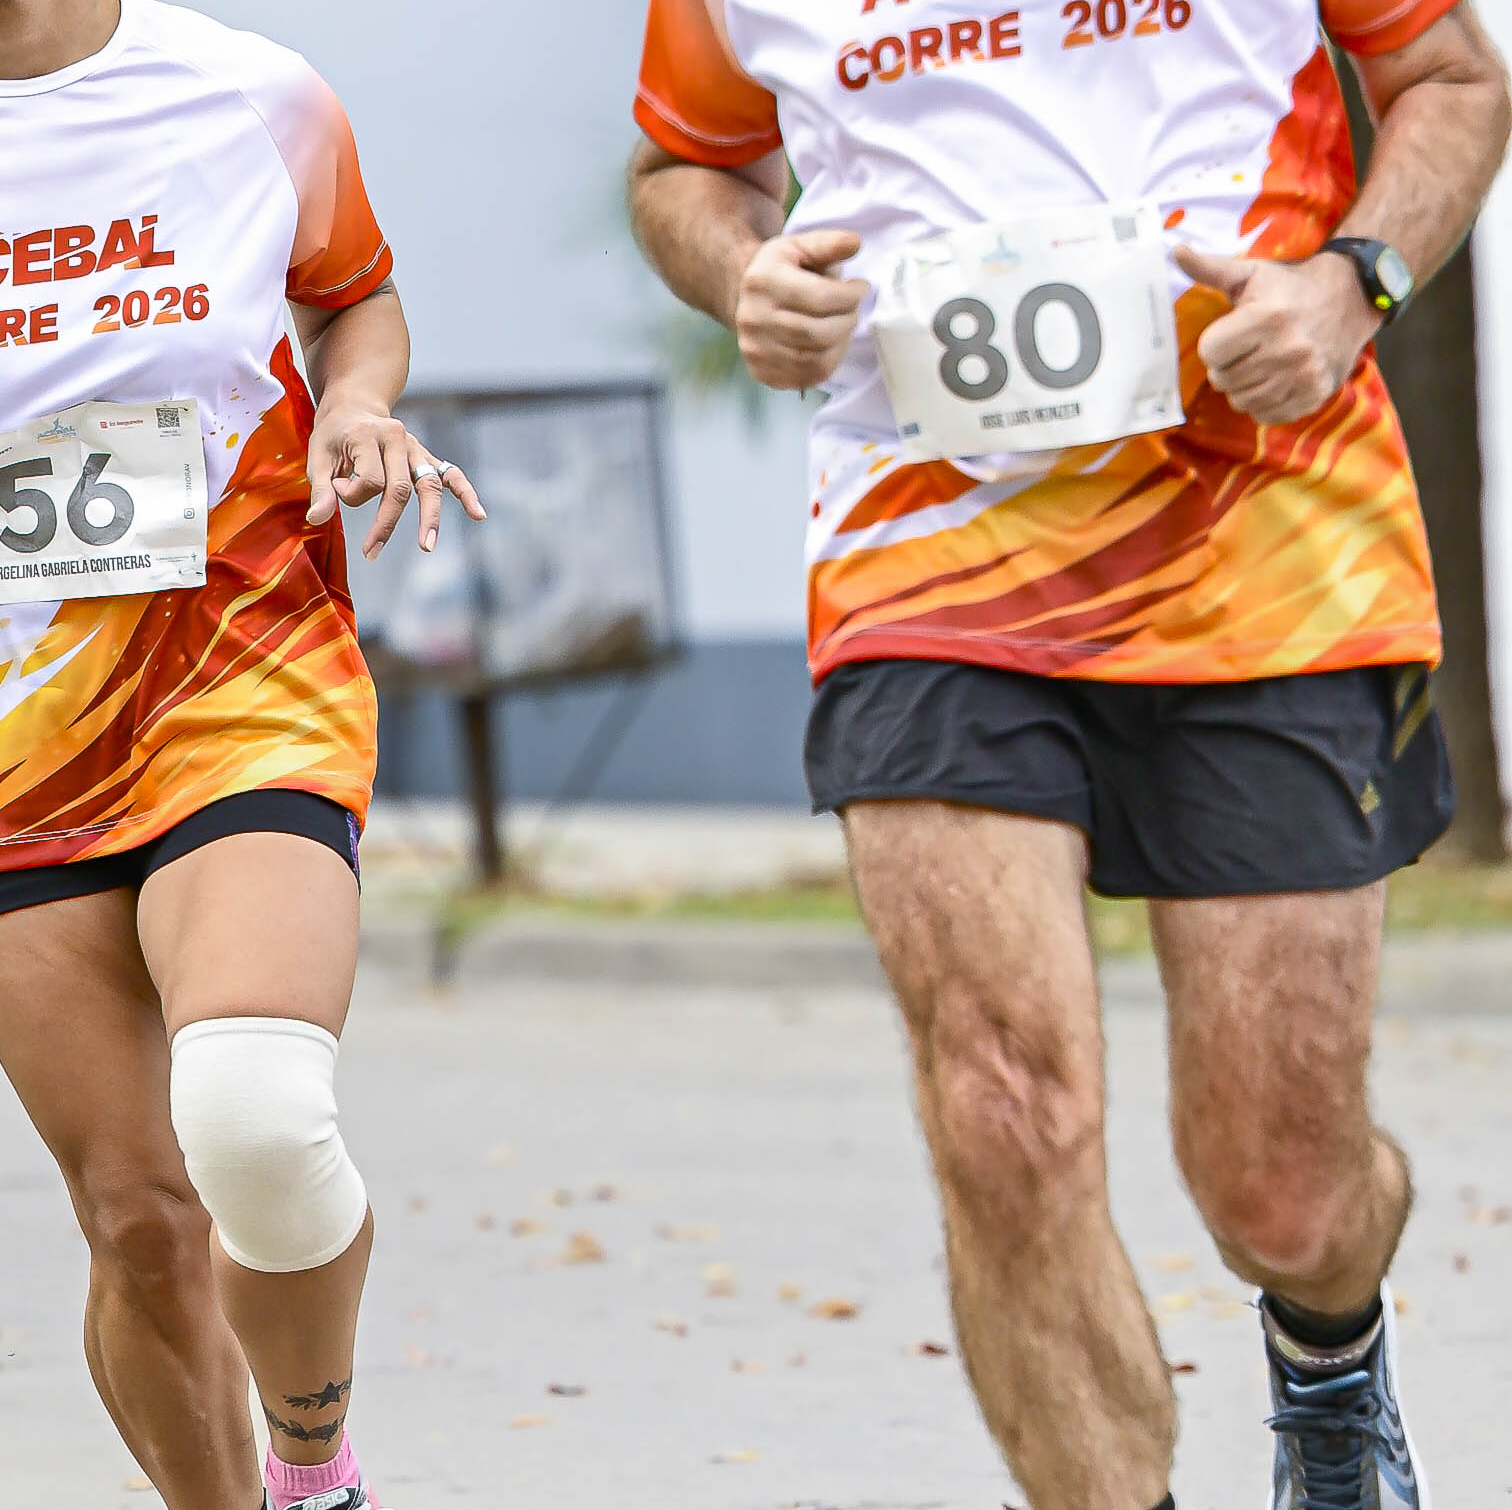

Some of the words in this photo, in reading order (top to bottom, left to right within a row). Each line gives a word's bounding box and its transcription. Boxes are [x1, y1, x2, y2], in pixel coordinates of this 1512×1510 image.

[836, 11, 1022, 91] CORRE
[91, 283, 210, 335] 2026
[933, 282, 1102, 400] 80
[41, 559, 89, 578] GABRIELA
[90, 554, 152, 573] CONTRERAS
